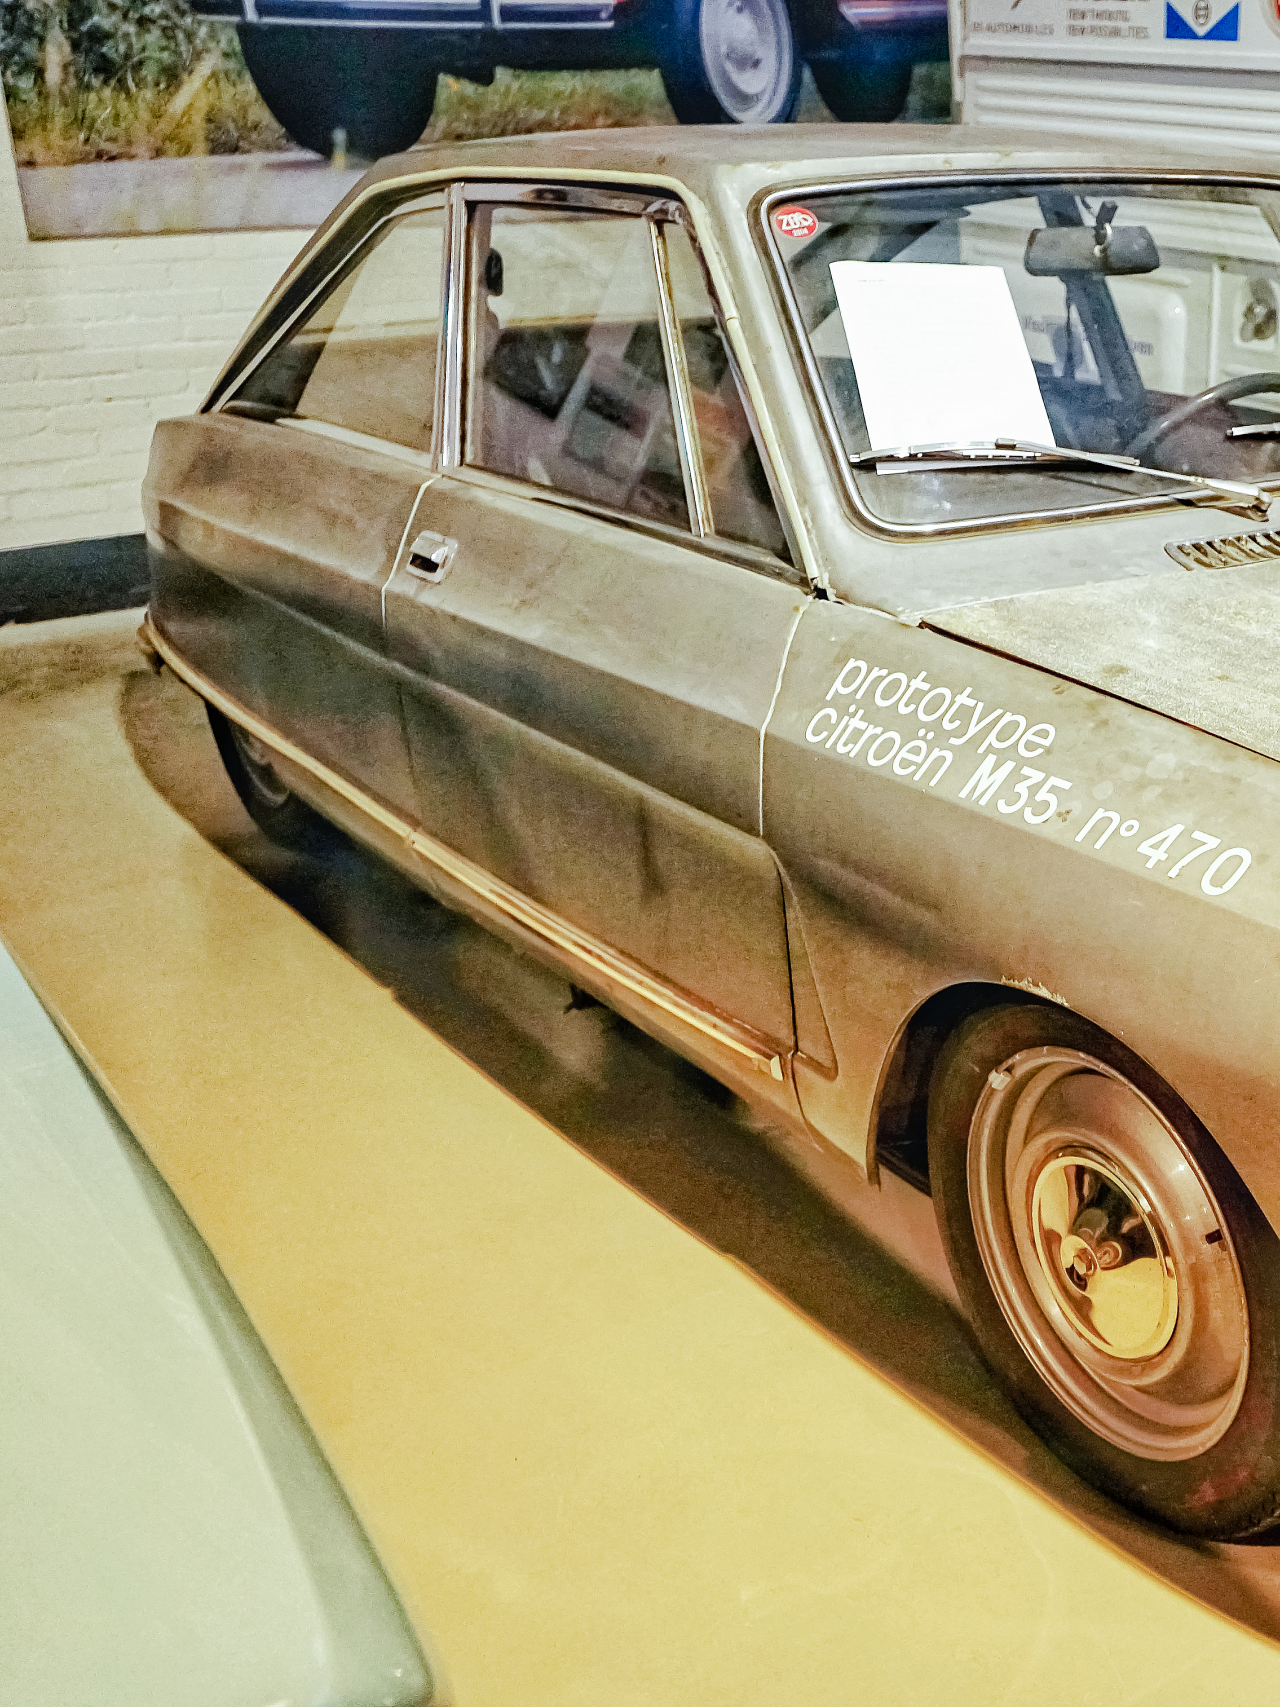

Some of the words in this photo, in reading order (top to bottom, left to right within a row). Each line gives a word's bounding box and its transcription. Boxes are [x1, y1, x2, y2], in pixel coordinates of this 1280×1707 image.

[825, 657, 1056, 759] prototype
[804, 704, 954, 788] citroën
[958, 753, 1073, 825] M35
